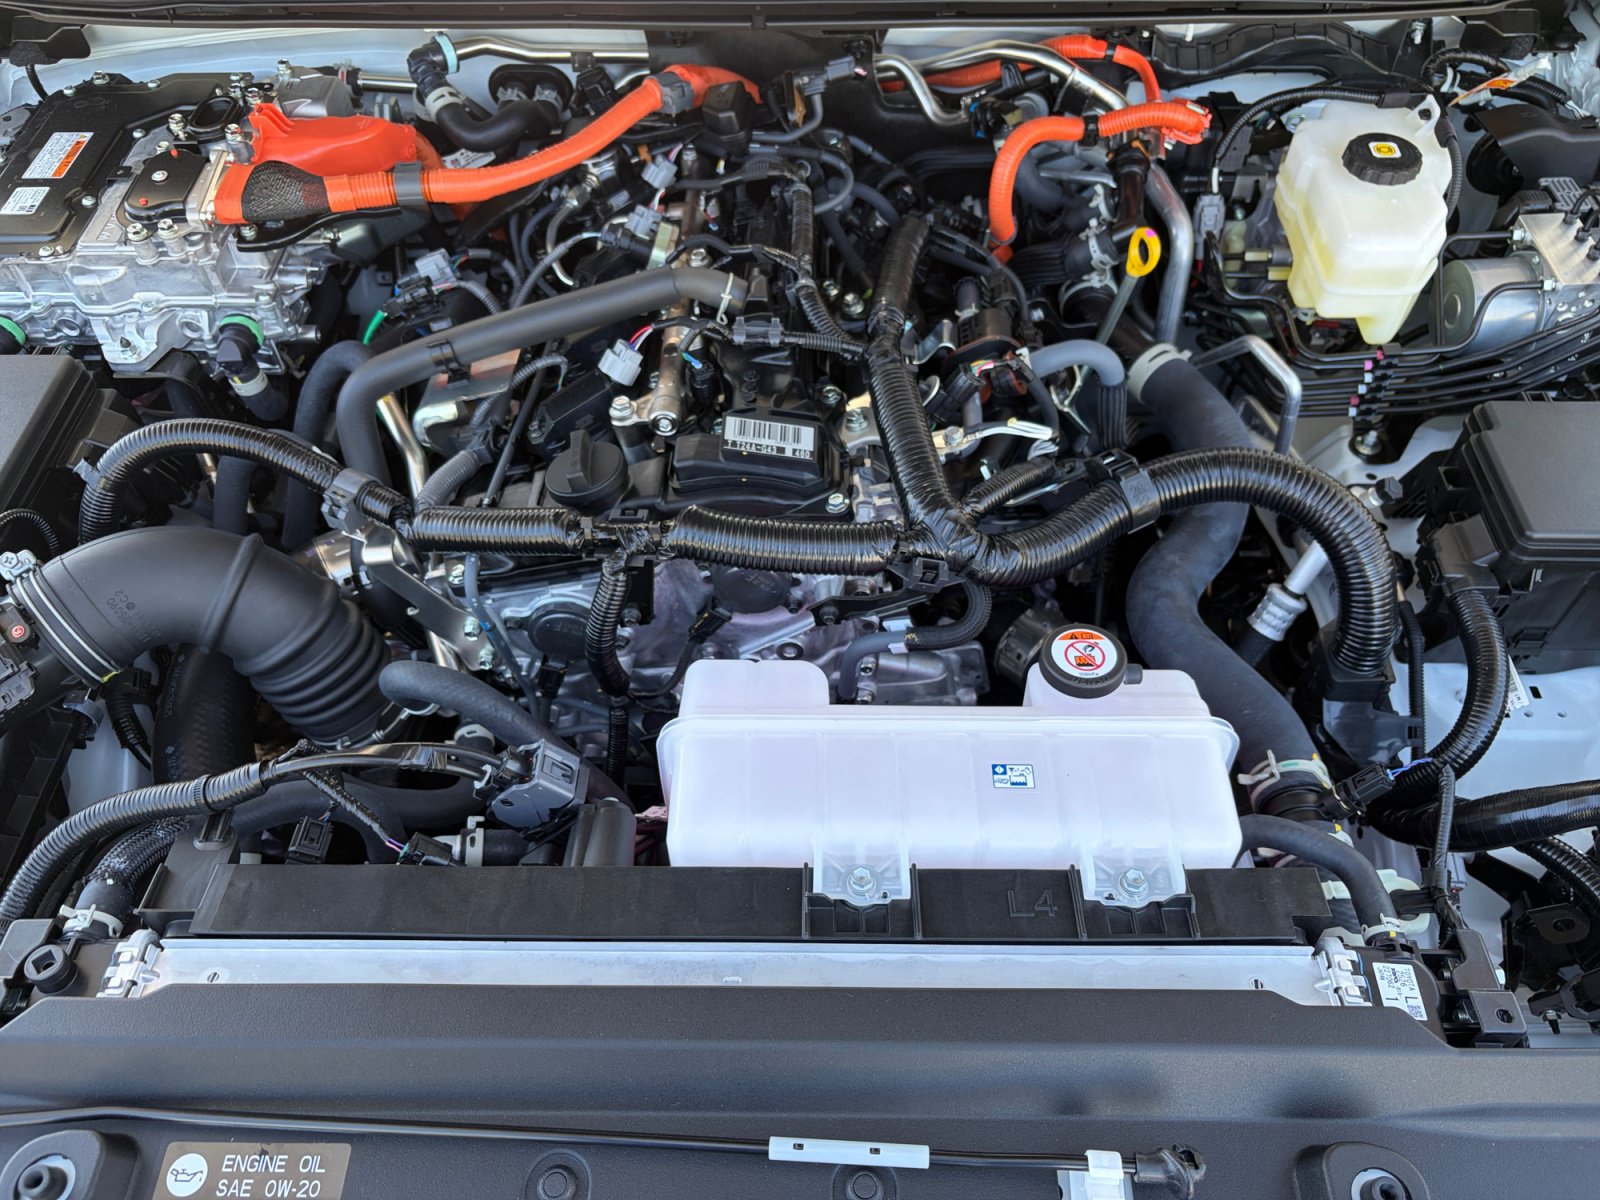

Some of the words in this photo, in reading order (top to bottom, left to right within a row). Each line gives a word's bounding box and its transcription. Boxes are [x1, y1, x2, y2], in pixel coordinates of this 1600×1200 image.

[735, 441, 777, 454] T24A-G43
[1007, 889, 1058, 917] L4
[1404, 968, 1415, 991] TOYOTA
[1405, 996, 1418, 1004] L
[221, 1154, 289, 1173] ENGINE
[299, 1154, 326, 1173] OIL
[215, 1179, 254, 1198] SAE
[264, 1179, 321, 1198] 0W-20
